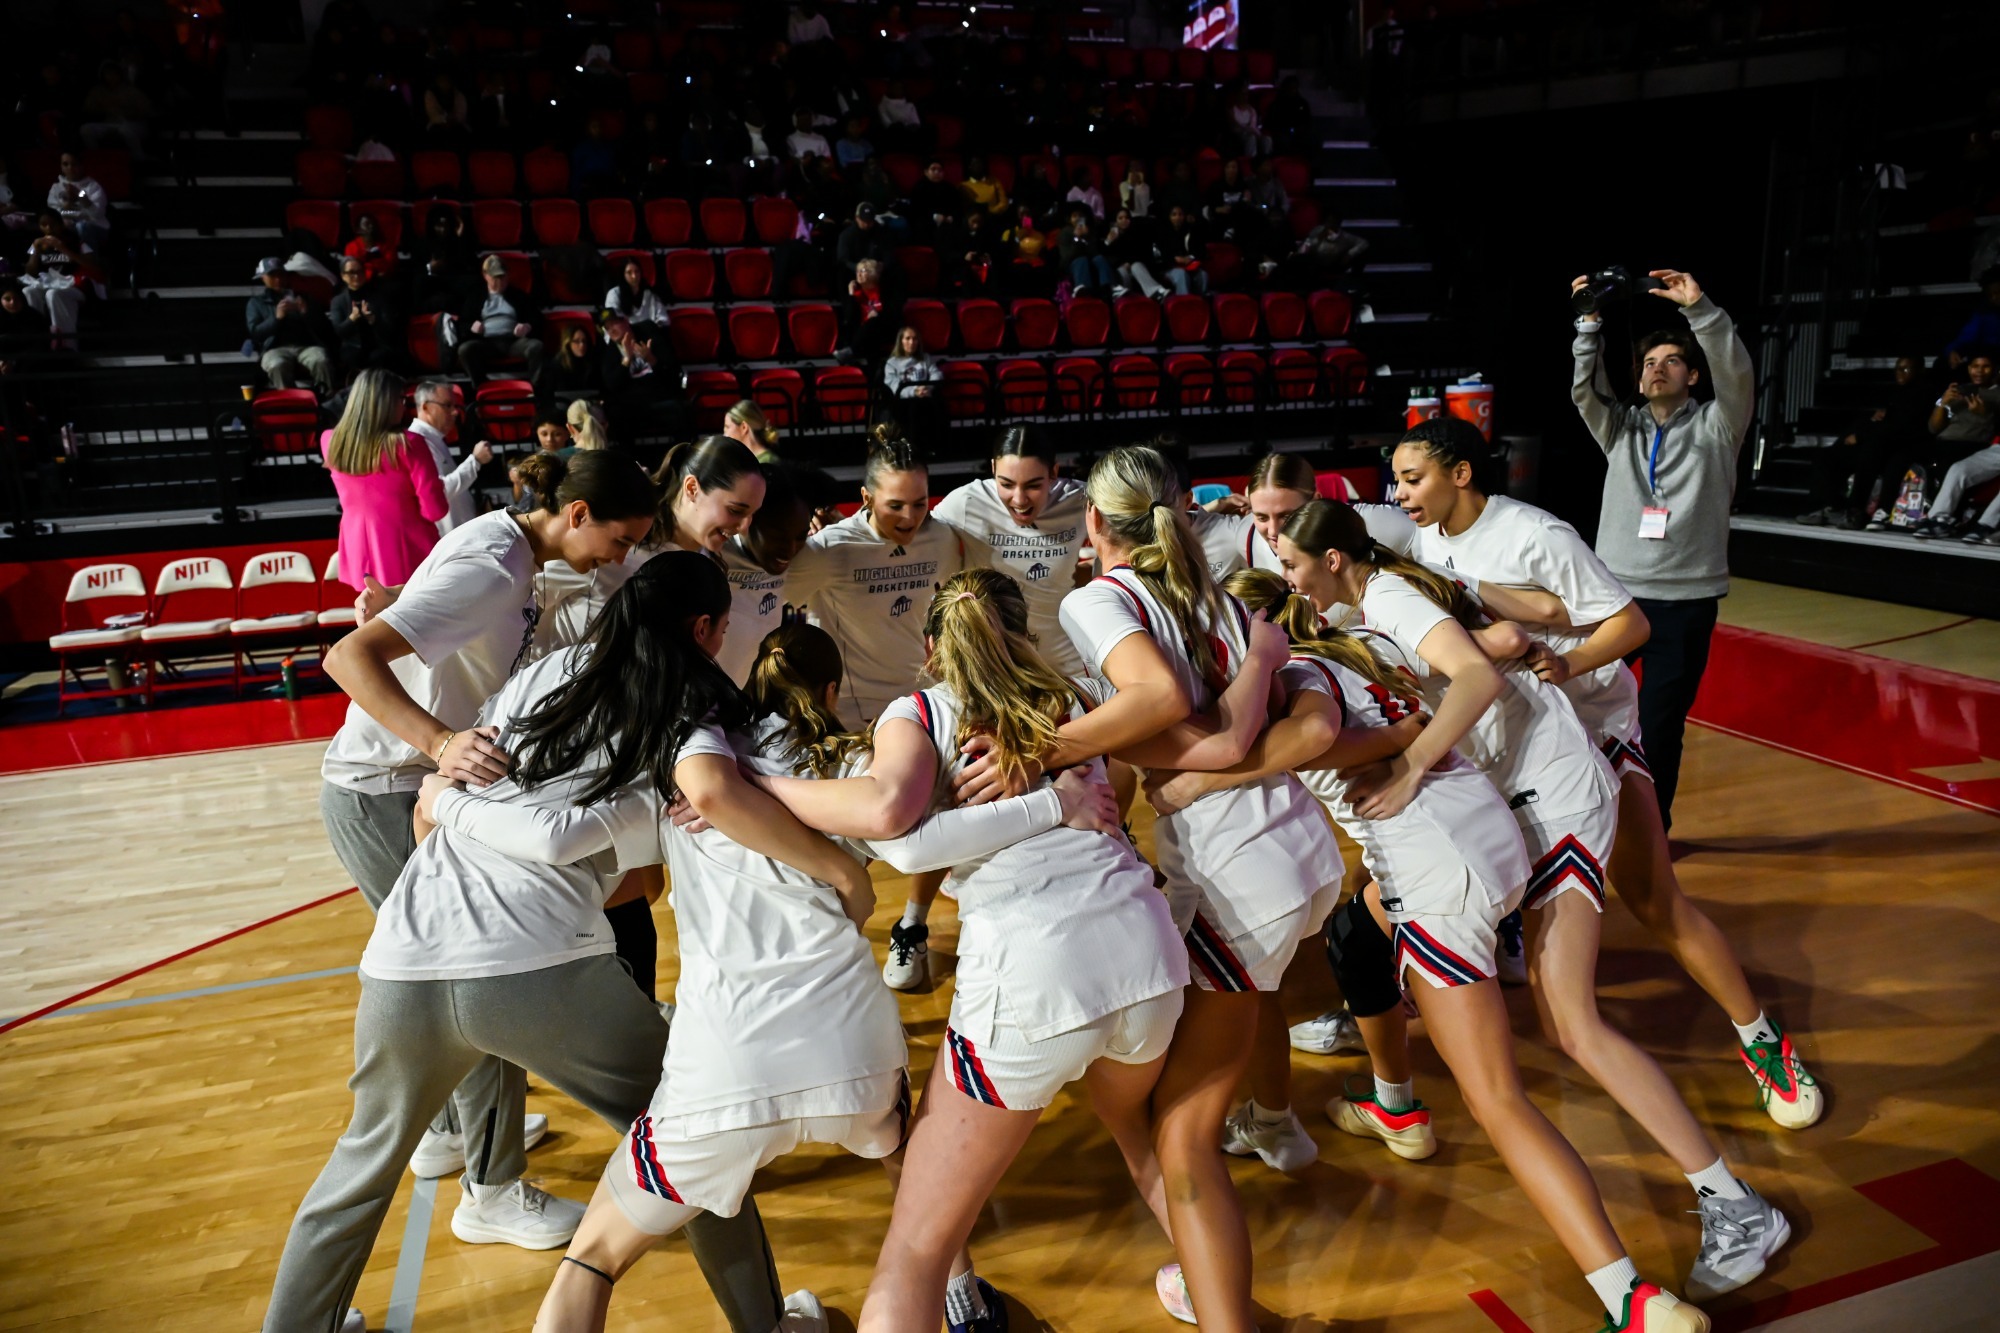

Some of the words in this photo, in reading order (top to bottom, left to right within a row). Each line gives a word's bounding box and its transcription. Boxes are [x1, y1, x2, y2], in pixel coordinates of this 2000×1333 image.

[1478, 402, 1490, 417] G
[989, 527, 1077, 547] HIGHLANDERS
[1002, 546, 1068, 559] BASKETBALL
[174, 560, 212, 581] NJIT
[259, 555, 296, 576] NJIT
[854, 561, 938, 581] HIGHLANDERS
[87, 568, 126, 589] NJIT
[1026, 568, 1050, 582] NJIT
[869, 579, 929, 594] BASKETBALL
[759, 598, 777, 616] NJIT
[890, 601, 912, 617] NJIT
